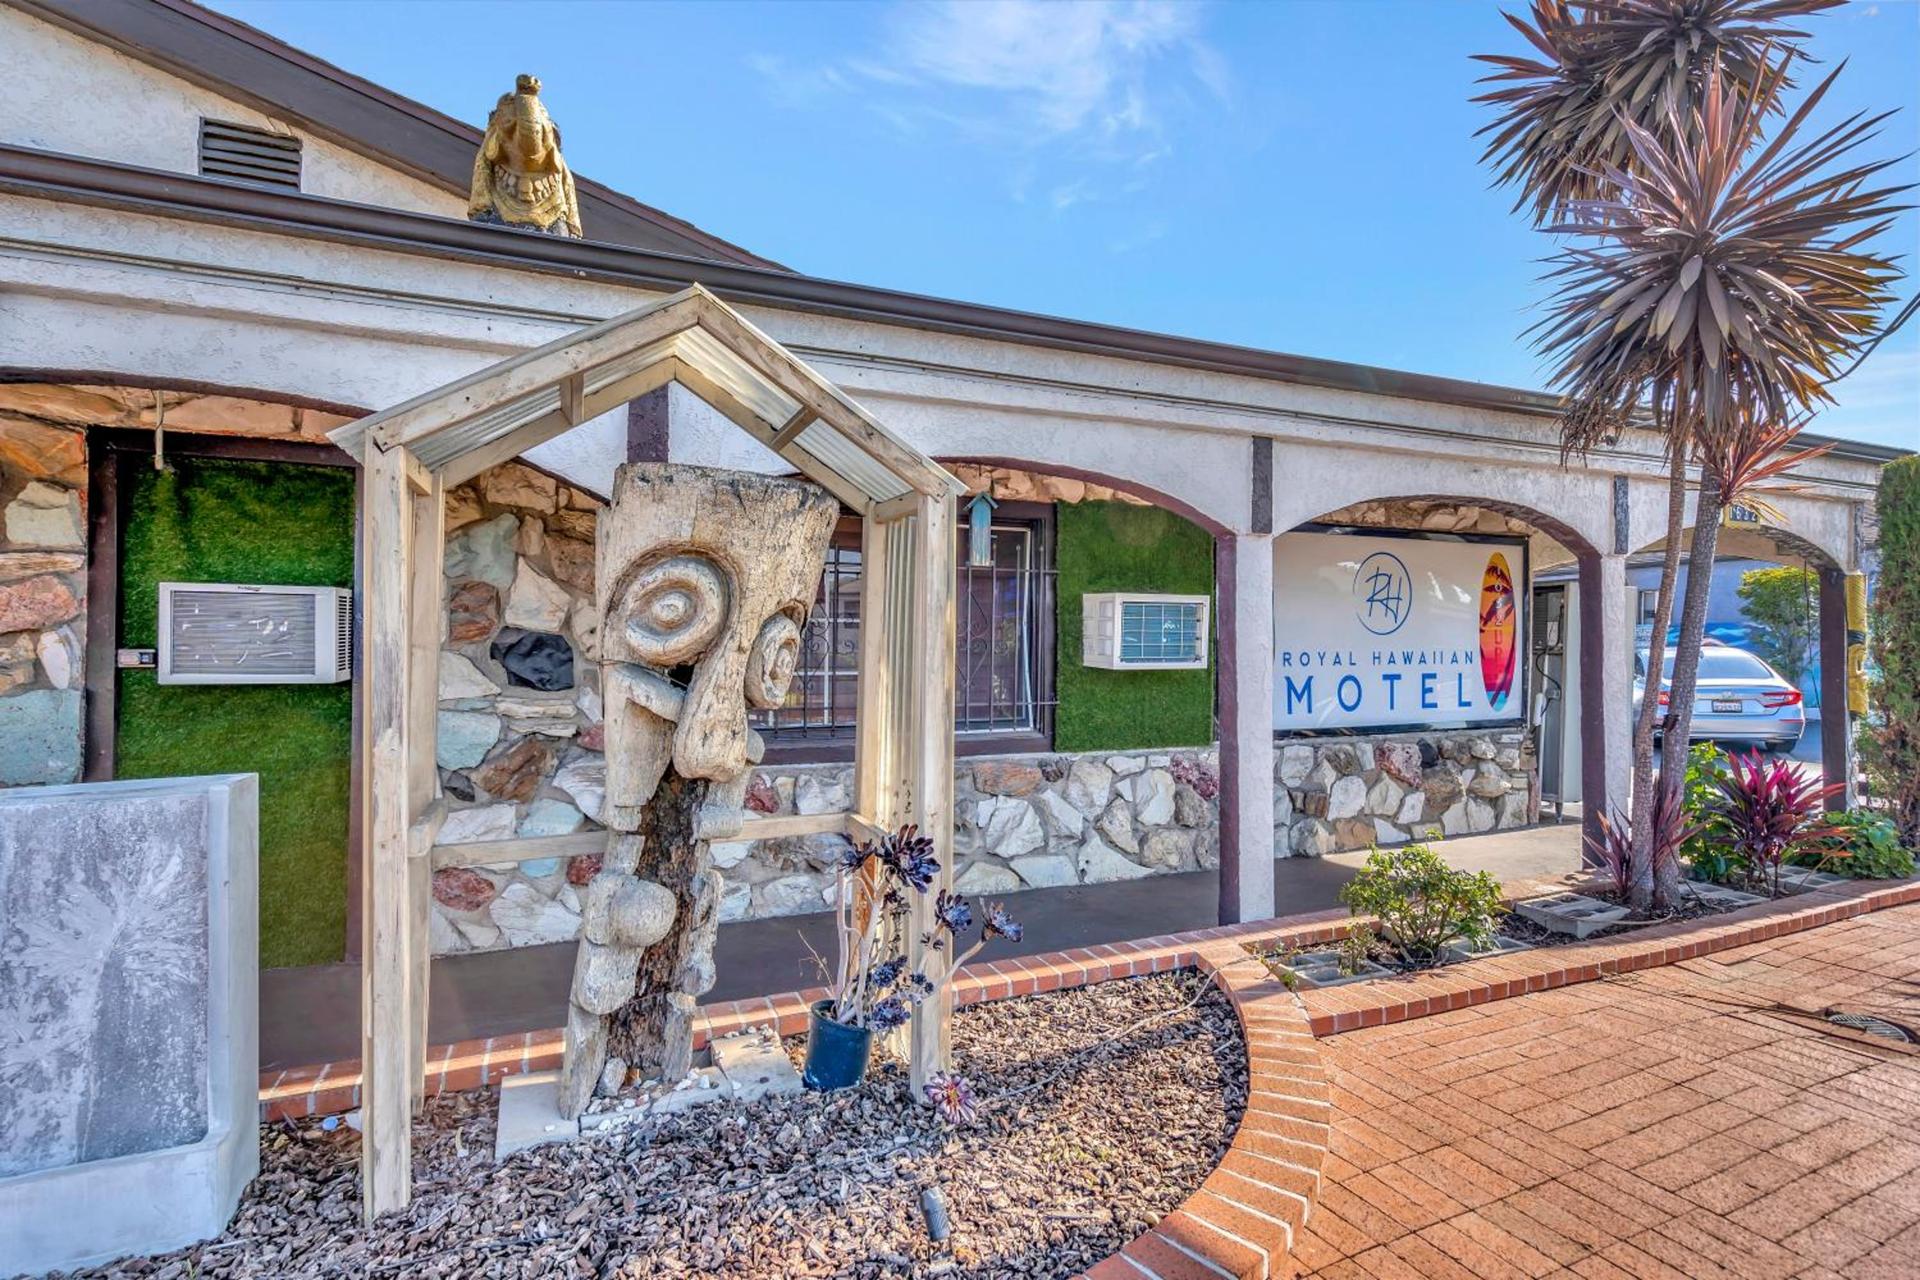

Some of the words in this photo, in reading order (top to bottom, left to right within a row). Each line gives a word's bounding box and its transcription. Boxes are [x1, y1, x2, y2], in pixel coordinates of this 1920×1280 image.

[1283, 651, 1357, 667] ROYAL
[1372, 650, 1473, 666] HAWAIIAN
[1284, 672, 1472, 715] MOTEL
